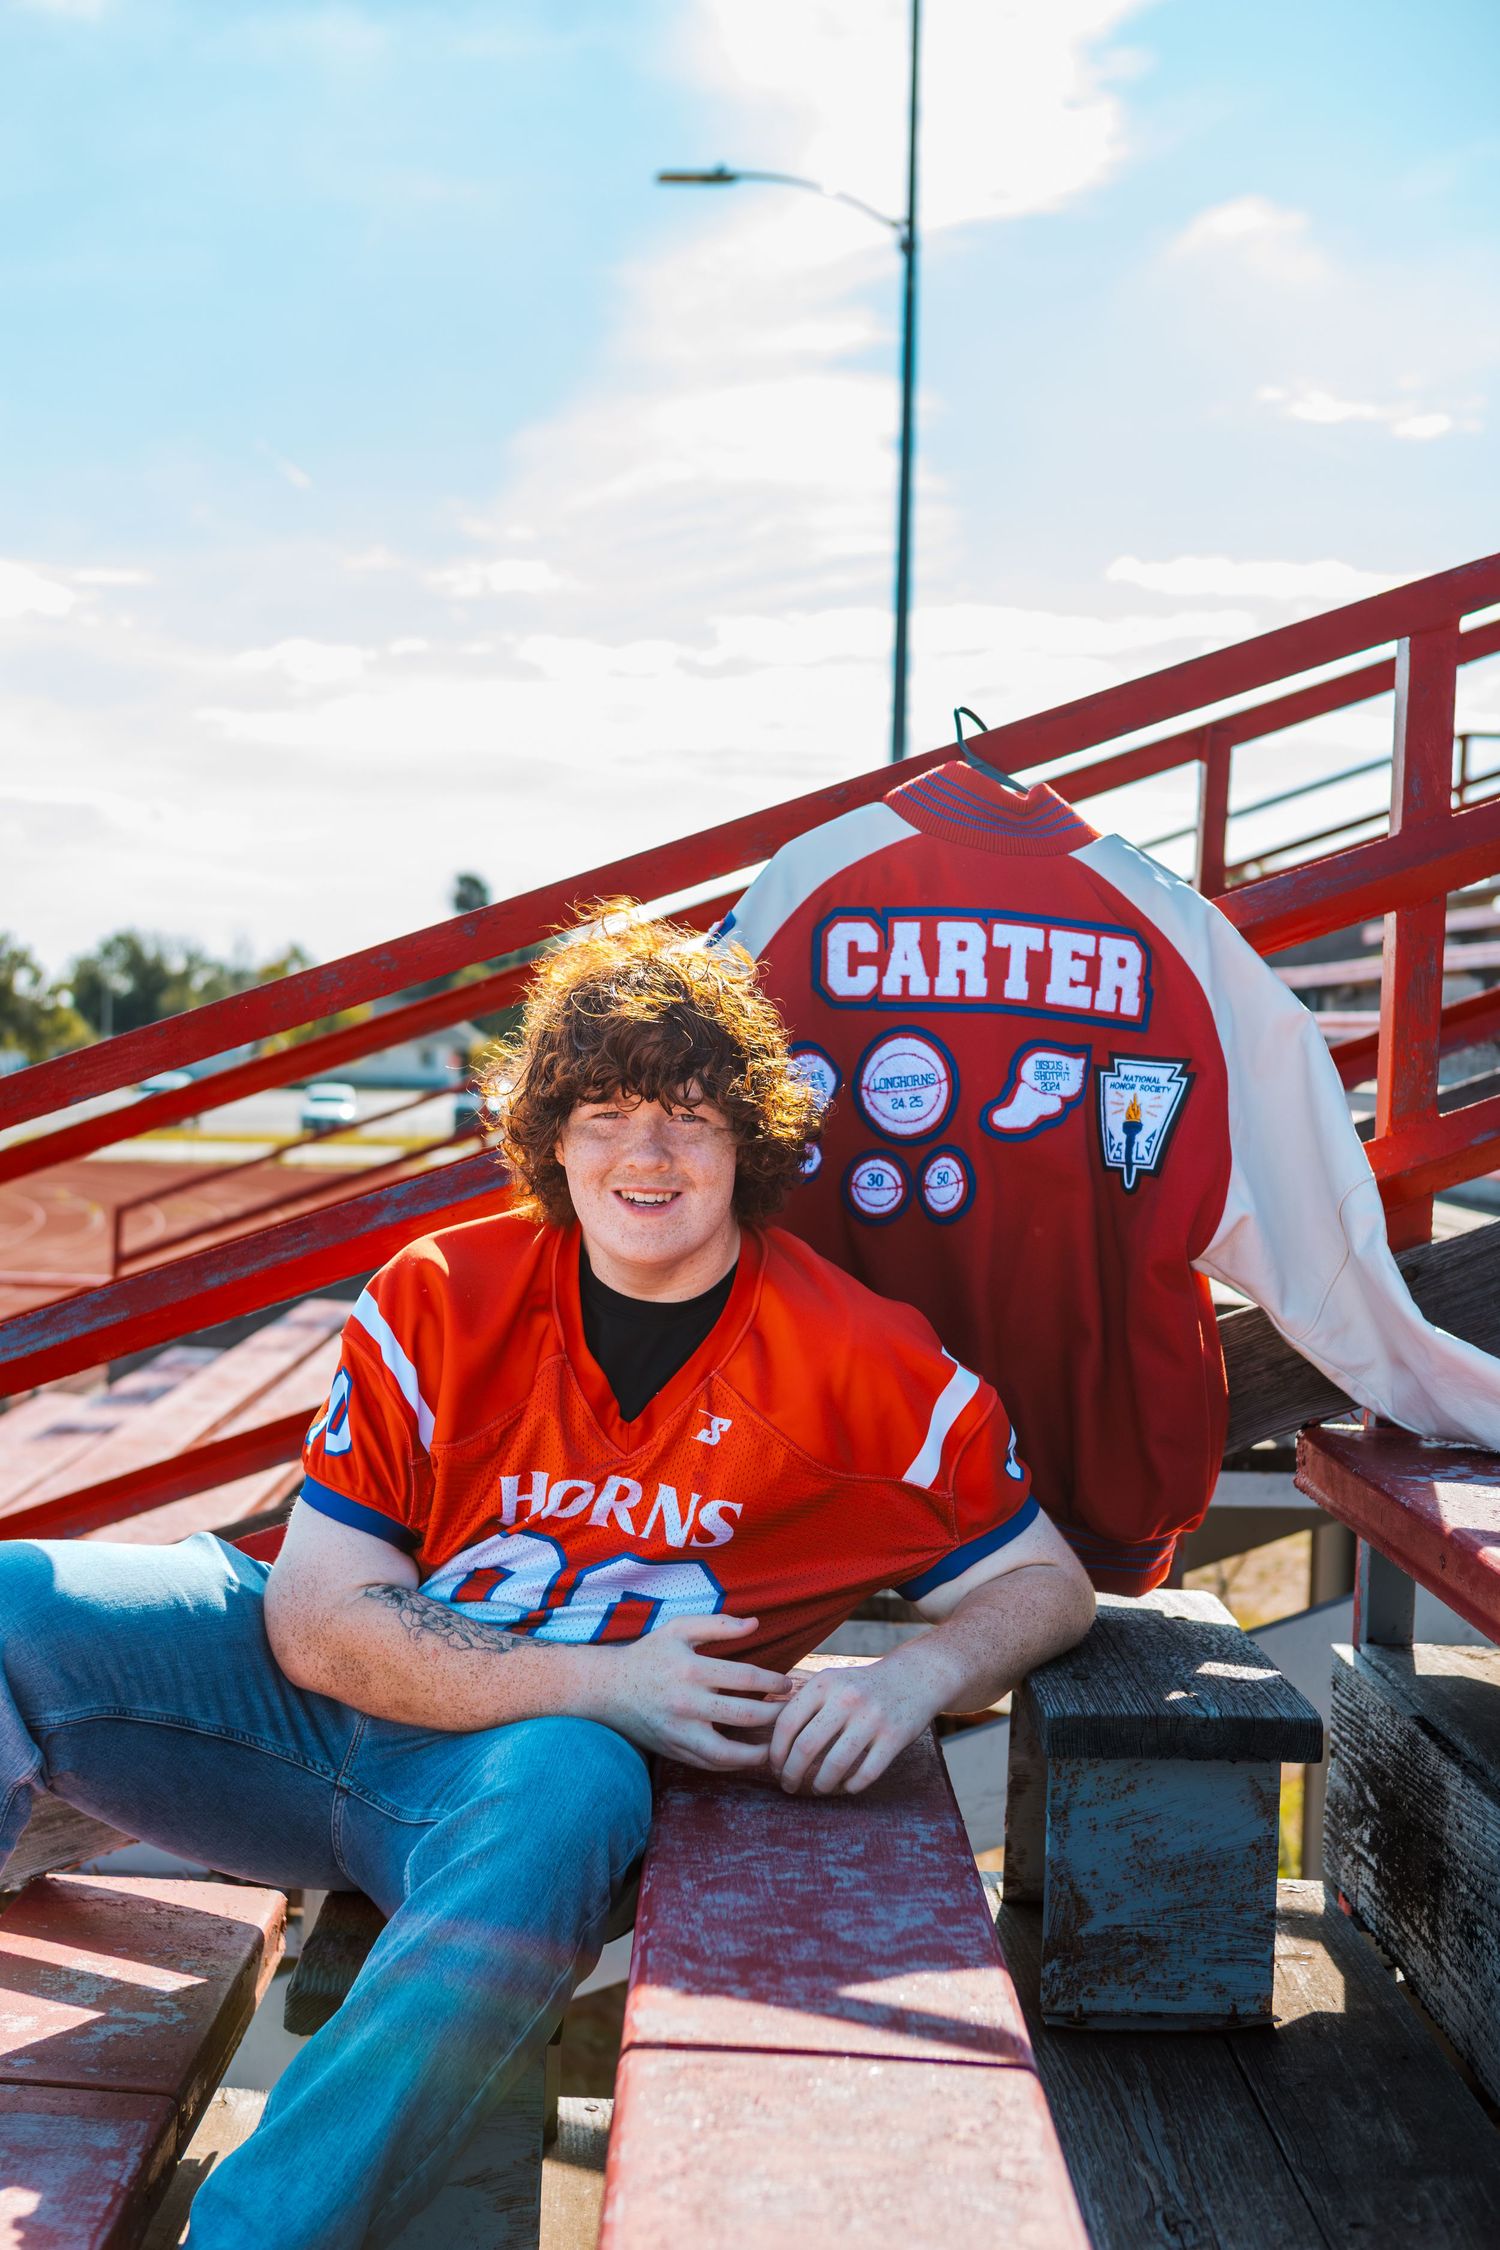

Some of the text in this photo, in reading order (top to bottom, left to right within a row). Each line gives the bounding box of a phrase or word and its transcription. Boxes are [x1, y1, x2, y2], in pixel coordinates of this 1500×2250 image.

[827, 921, 1143, 1016] CARTER
[1035, 1060, 1063, 1070] DISCUS
[873, 1073, 936, 1090] LONGHORNS
[1122, 1074, 1161, 1084] NATIONAL
[1040, 1082, 1060, 1091] 2024
[1109, 1082, 1171, 1093] HONOR SOCIETY
[866, 1173, 884, 1187] 30
[936, 1171, 949, 1186] 50
[496, 1470, 744, 1549] HORNS
